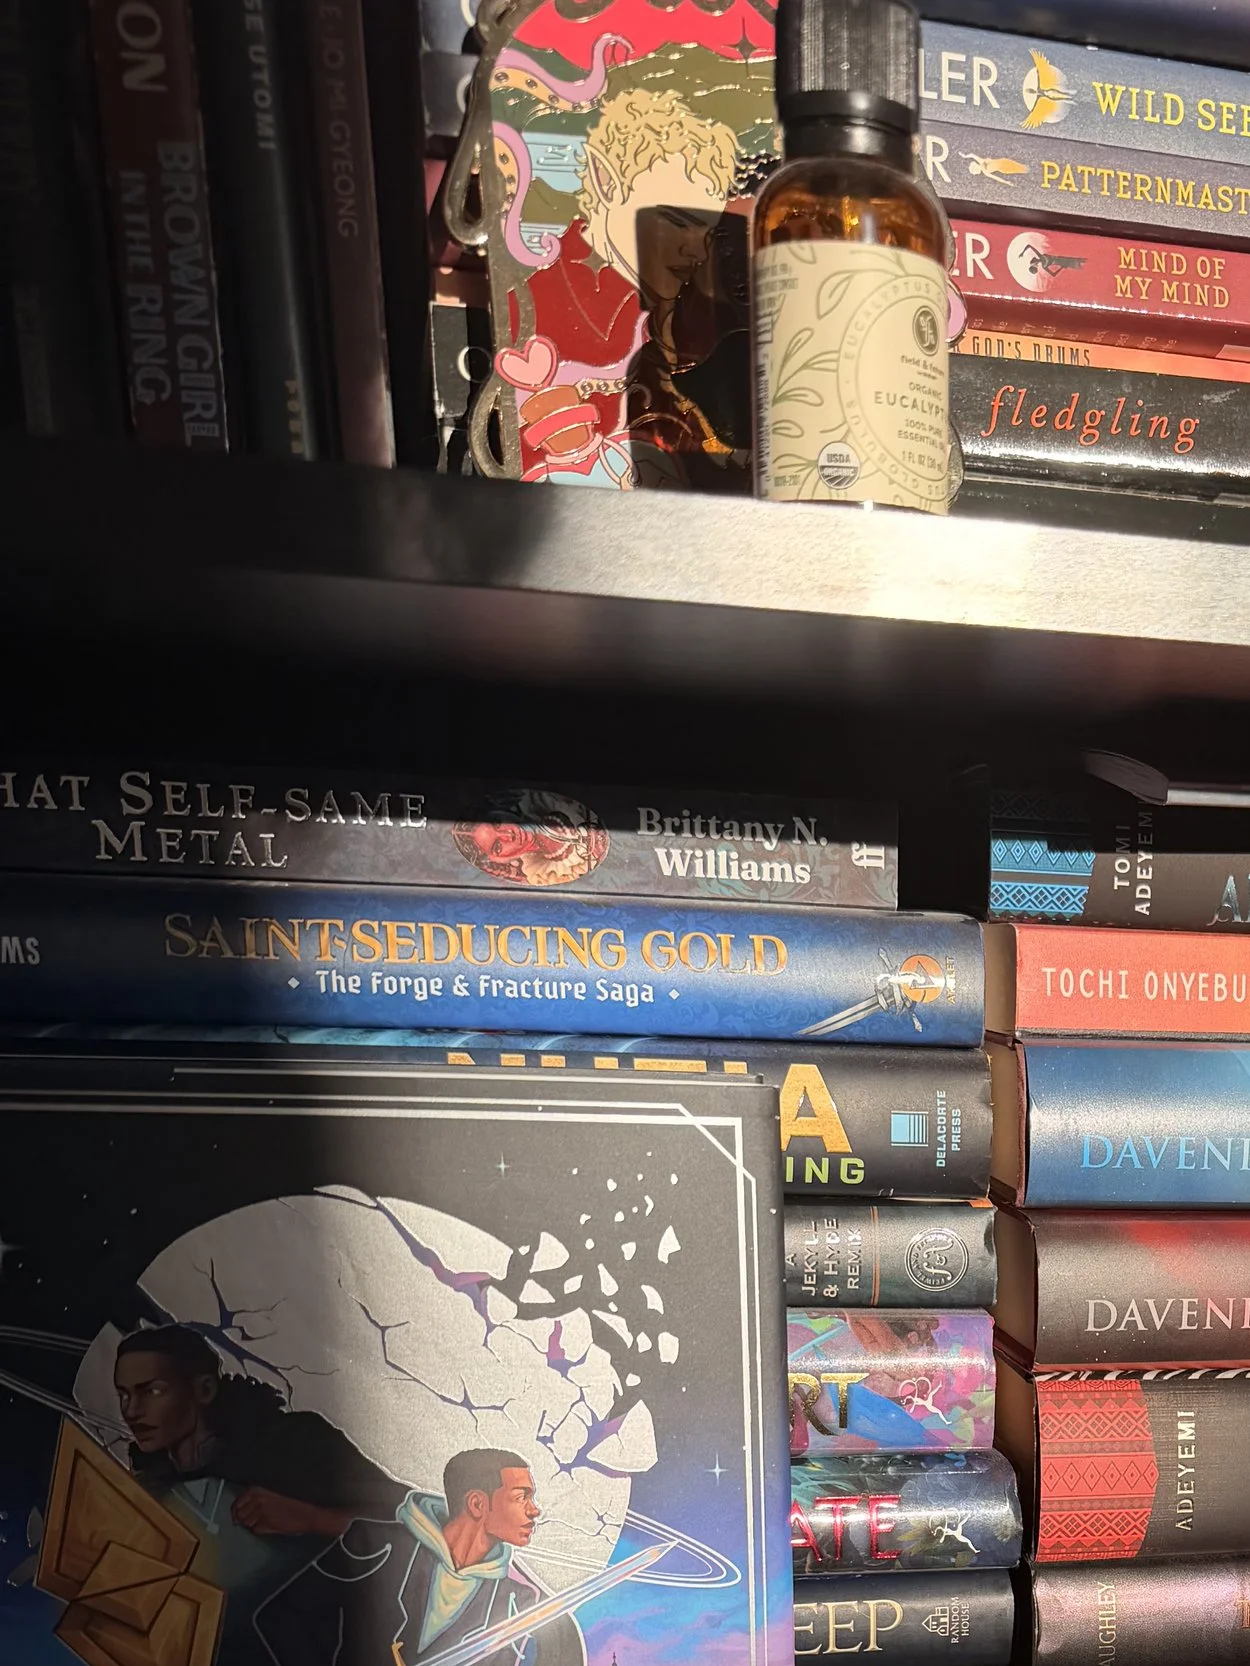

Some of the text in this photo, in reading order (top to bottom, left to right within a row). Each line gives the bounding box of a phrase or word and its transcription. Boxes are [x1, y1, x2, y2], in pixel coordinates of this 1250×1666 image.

[1092, 81, 1185, 127] WILD
[1117, 246, 1188, 277] MIND
[123, 210, 173, 405] THE RING
[157, 140, 220, 447] BROWN GIRL
[1114, 274, 1230, 309] MY MIND
[980, 384, 1200, 455] fledgling
[826, 452, 850, 464] USDA
[118, 769, 429, 831] SELF-SAME
[90, 817, 289, 870] METAL
[654, 846, 812, 885] Williams
[1113, 824, 1133, 891] TOMI
[641, 930, 789, 977] GOLD
[370, 971, 655, 1008] Forge & Saga
[1041, 967, 1130, 999] TOCHI
[936, 1090, 947, 1168] DELACORTE
[951, 1107, 962, 1152] PRESS
[847, 1229, 862, 1290] REMIX
[1175, 1410, 1196, 1531] ADEYEMI
